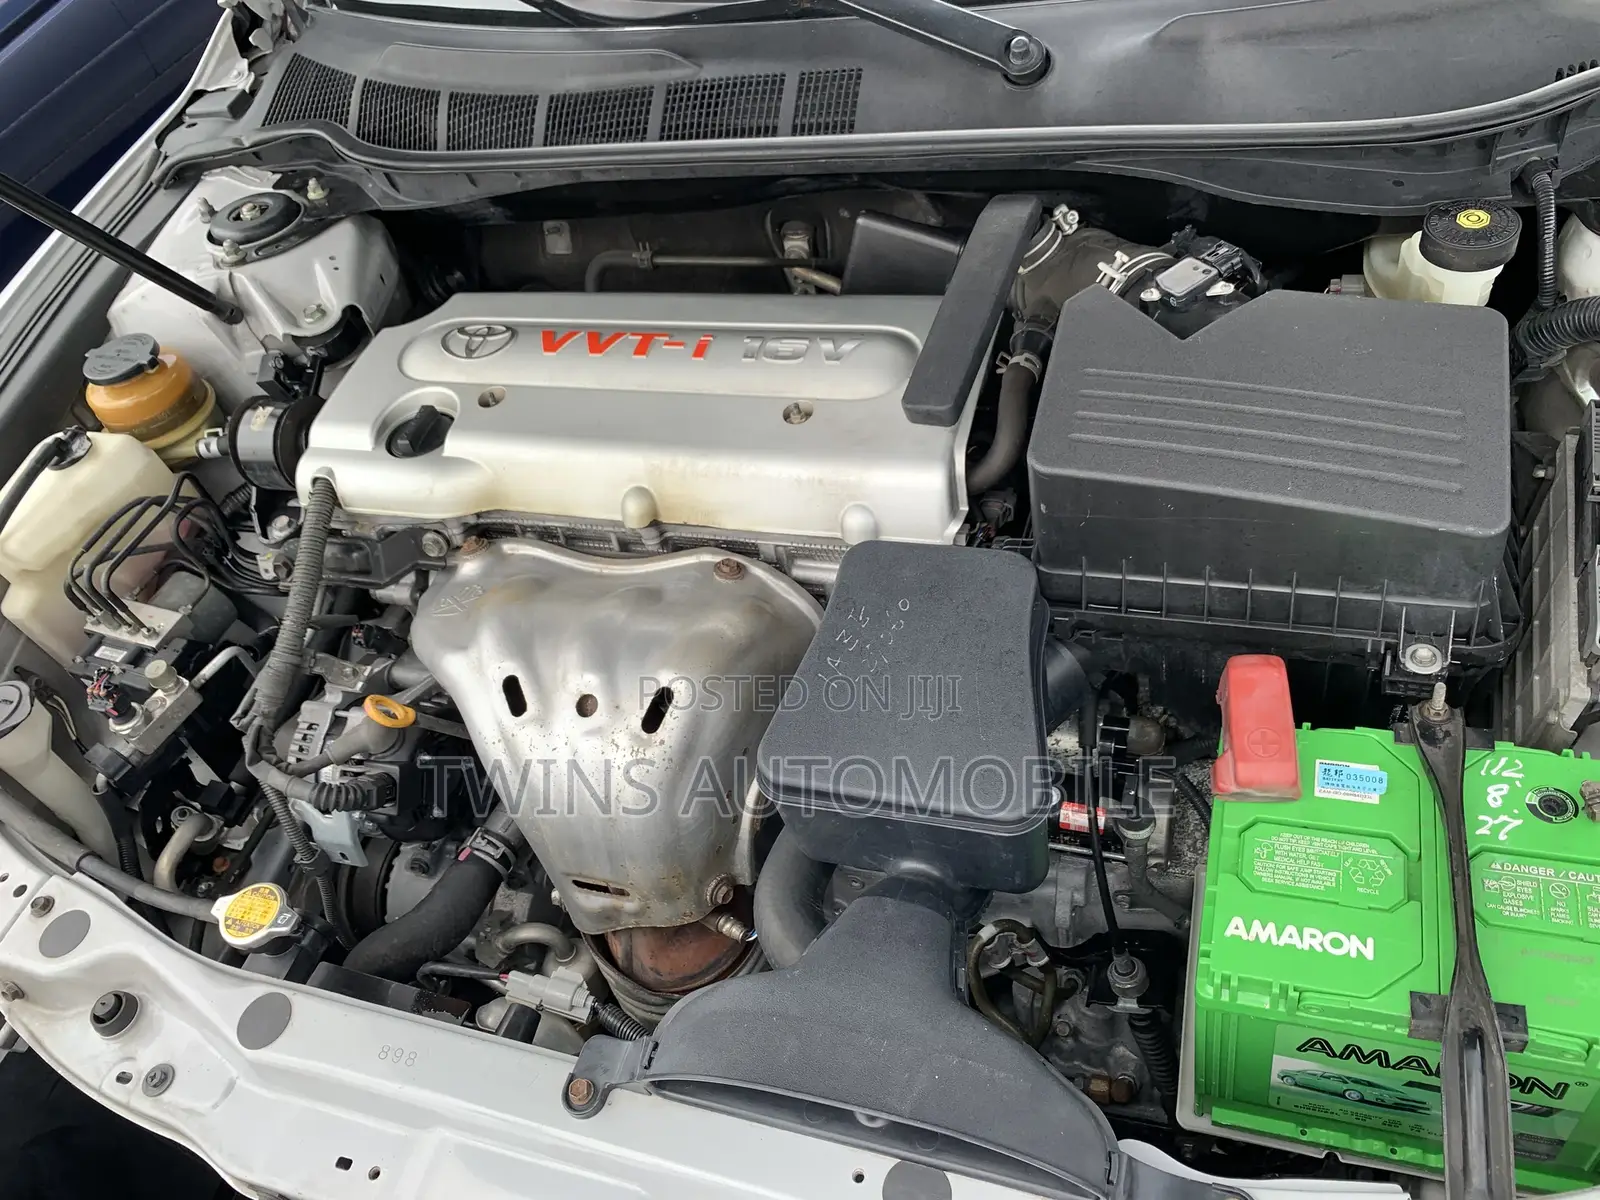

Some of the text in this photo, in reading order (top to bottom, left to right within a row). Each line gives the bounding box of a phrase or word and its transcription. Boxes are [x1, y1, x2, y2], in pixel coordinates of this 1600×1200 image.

[541, 330, 864, 364] VVT-i 16V
[1346, 773, 1384, 784] 035008
[1503, 862, 1555, 877] DANGER
[1516, 880, 1538, 888] SHIELD
[1356, 887, 1380, 896] RECYCLE
[1502, 892, 1534, 901] EXPLOSIVE
[1503, 898, 1524, 906] GASES
[1224, 916, 1374, 961] AMARON
[378, 1044, 418, 1067] 898
